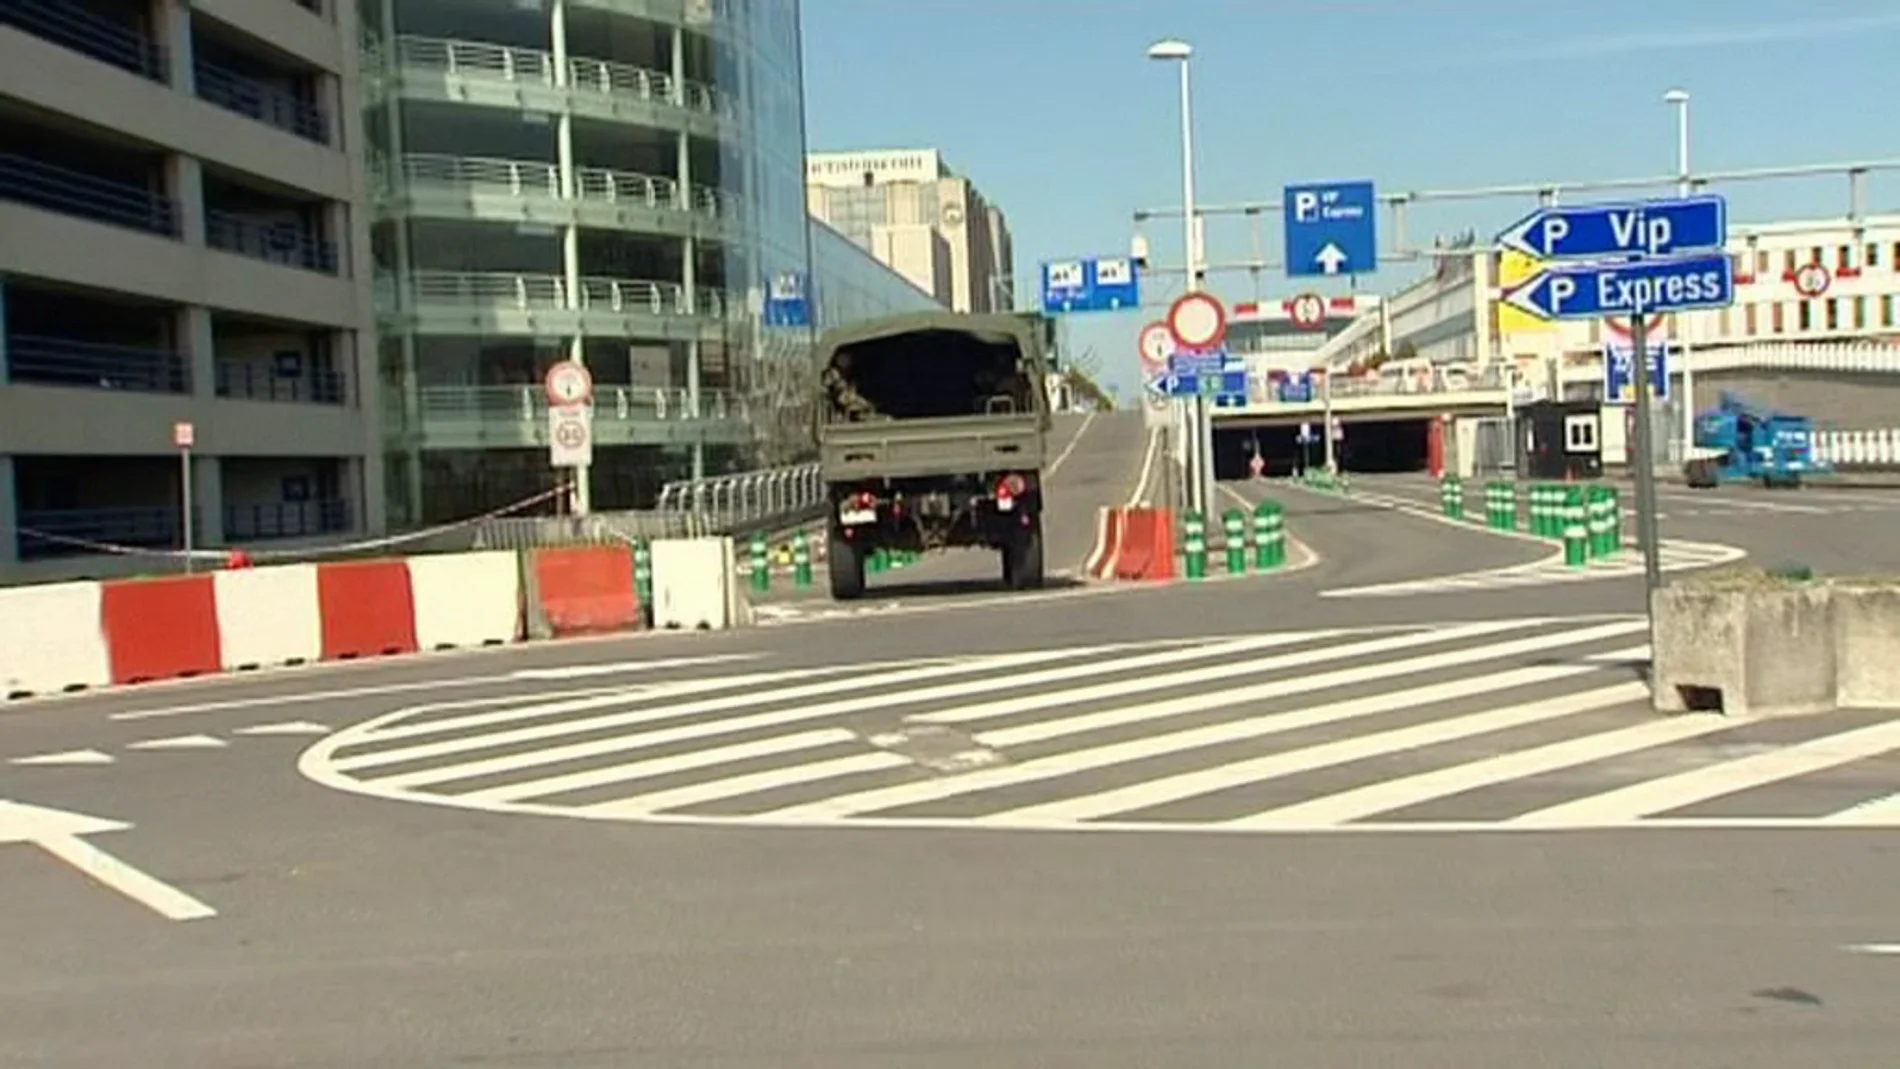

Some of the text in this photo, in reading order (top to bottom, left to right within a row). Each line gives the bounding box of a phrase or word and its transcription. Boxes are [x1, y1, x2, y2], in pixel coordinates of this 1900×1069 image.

[1543, 211, 1672, 252] P Vip
[1549, 271, 1720, 313] P Express
